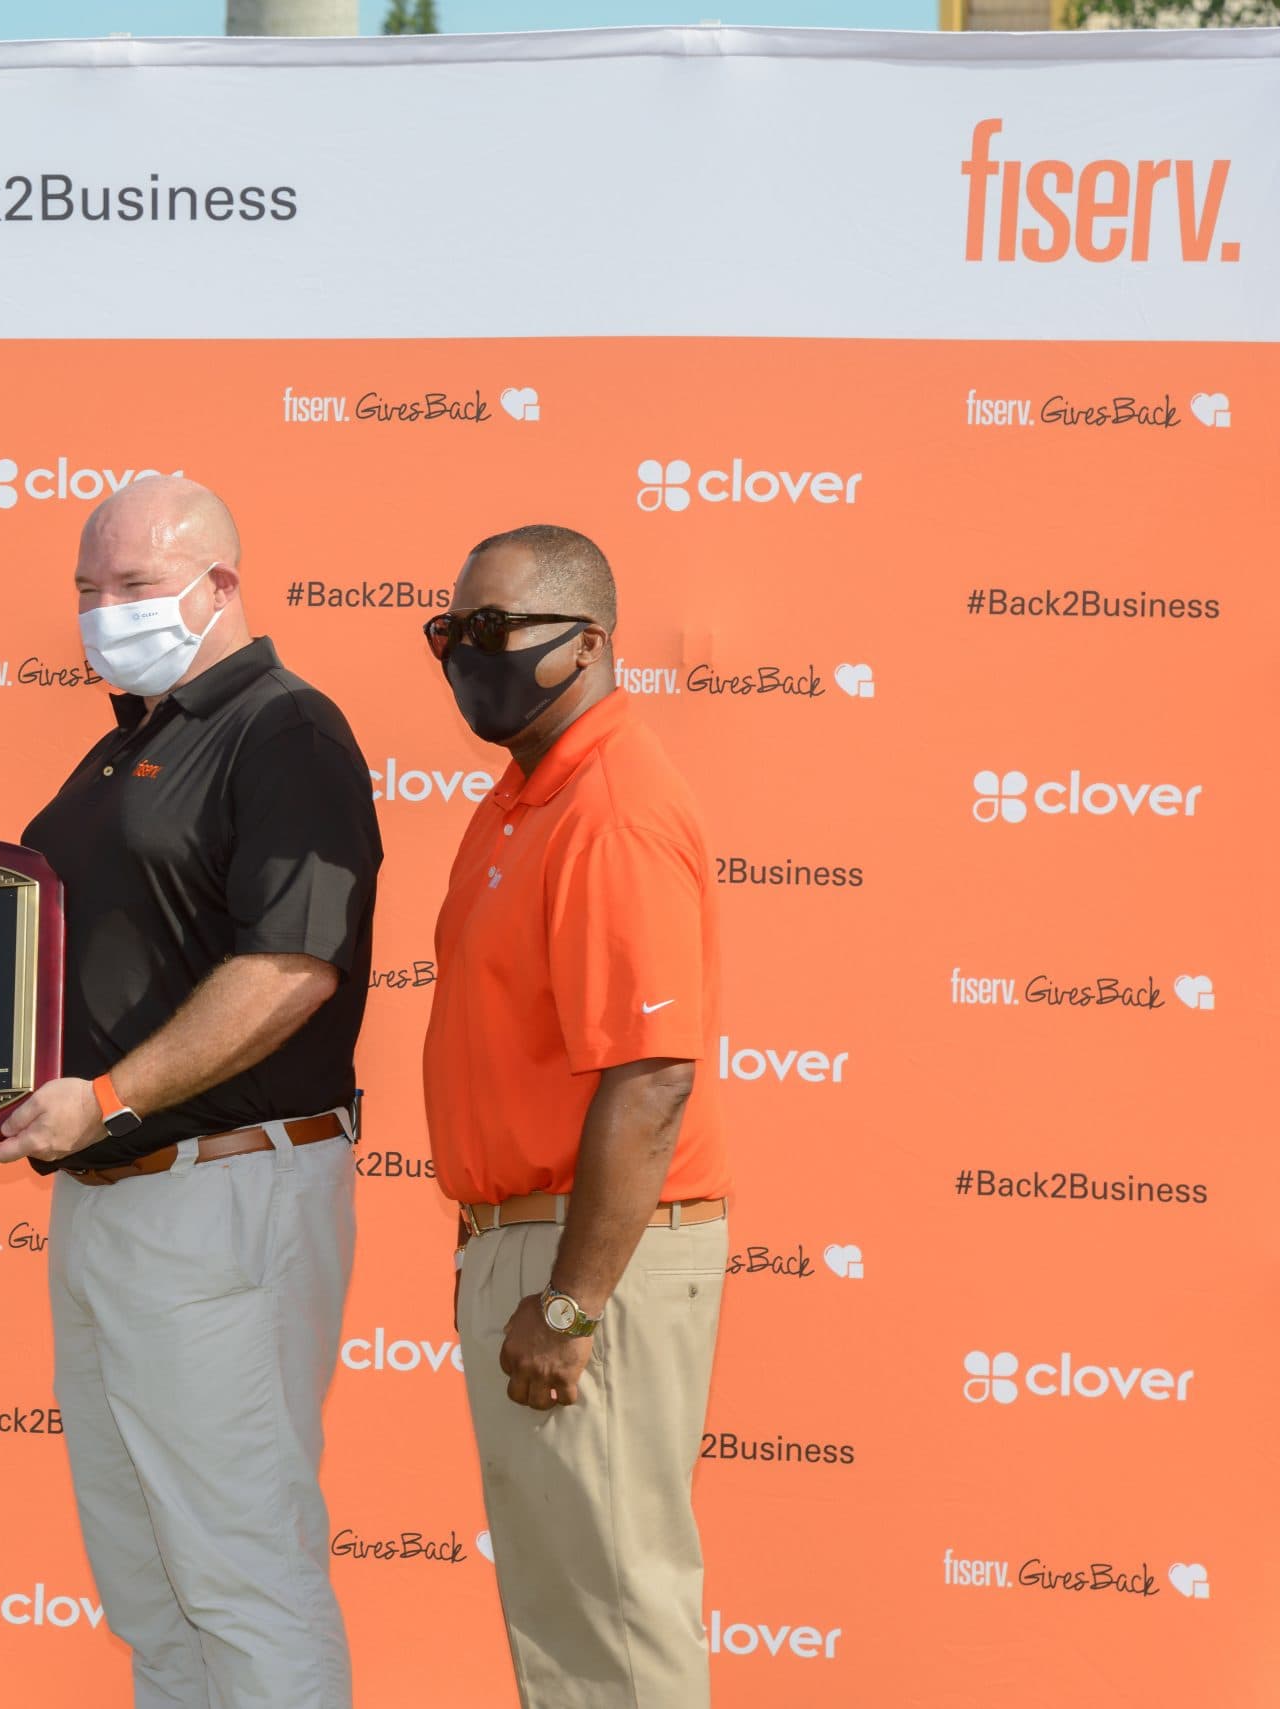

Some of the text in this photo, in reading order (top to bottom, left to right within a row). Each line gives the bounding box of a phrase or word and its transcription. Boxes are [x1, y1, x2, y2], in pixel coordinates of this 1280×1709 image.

[961, 118, 1241, 263] fiserv.
[282, 386, 350, 422] fiserv.
[966, 388, 1035, 426] fiserv.
[24, 457, 187, 500] clov
[697, 457, 863, 504] clover
[286, 581, 456, 608] #Back2Bus
[967, 588, 1220, 619] #Back2Business
[1034, 769, 1202, 817] clover
[950, 967, 1019, 1005] fiserv.
[719, 1035, 849, 1083] lover
[954, 1169, 1208, 1204] #Back2Business
[1025, 1351, 1194, 1401] clover
[943, 1548, 1012, 1587] fiserv.
[711, 1610, 842, 1659] lover
